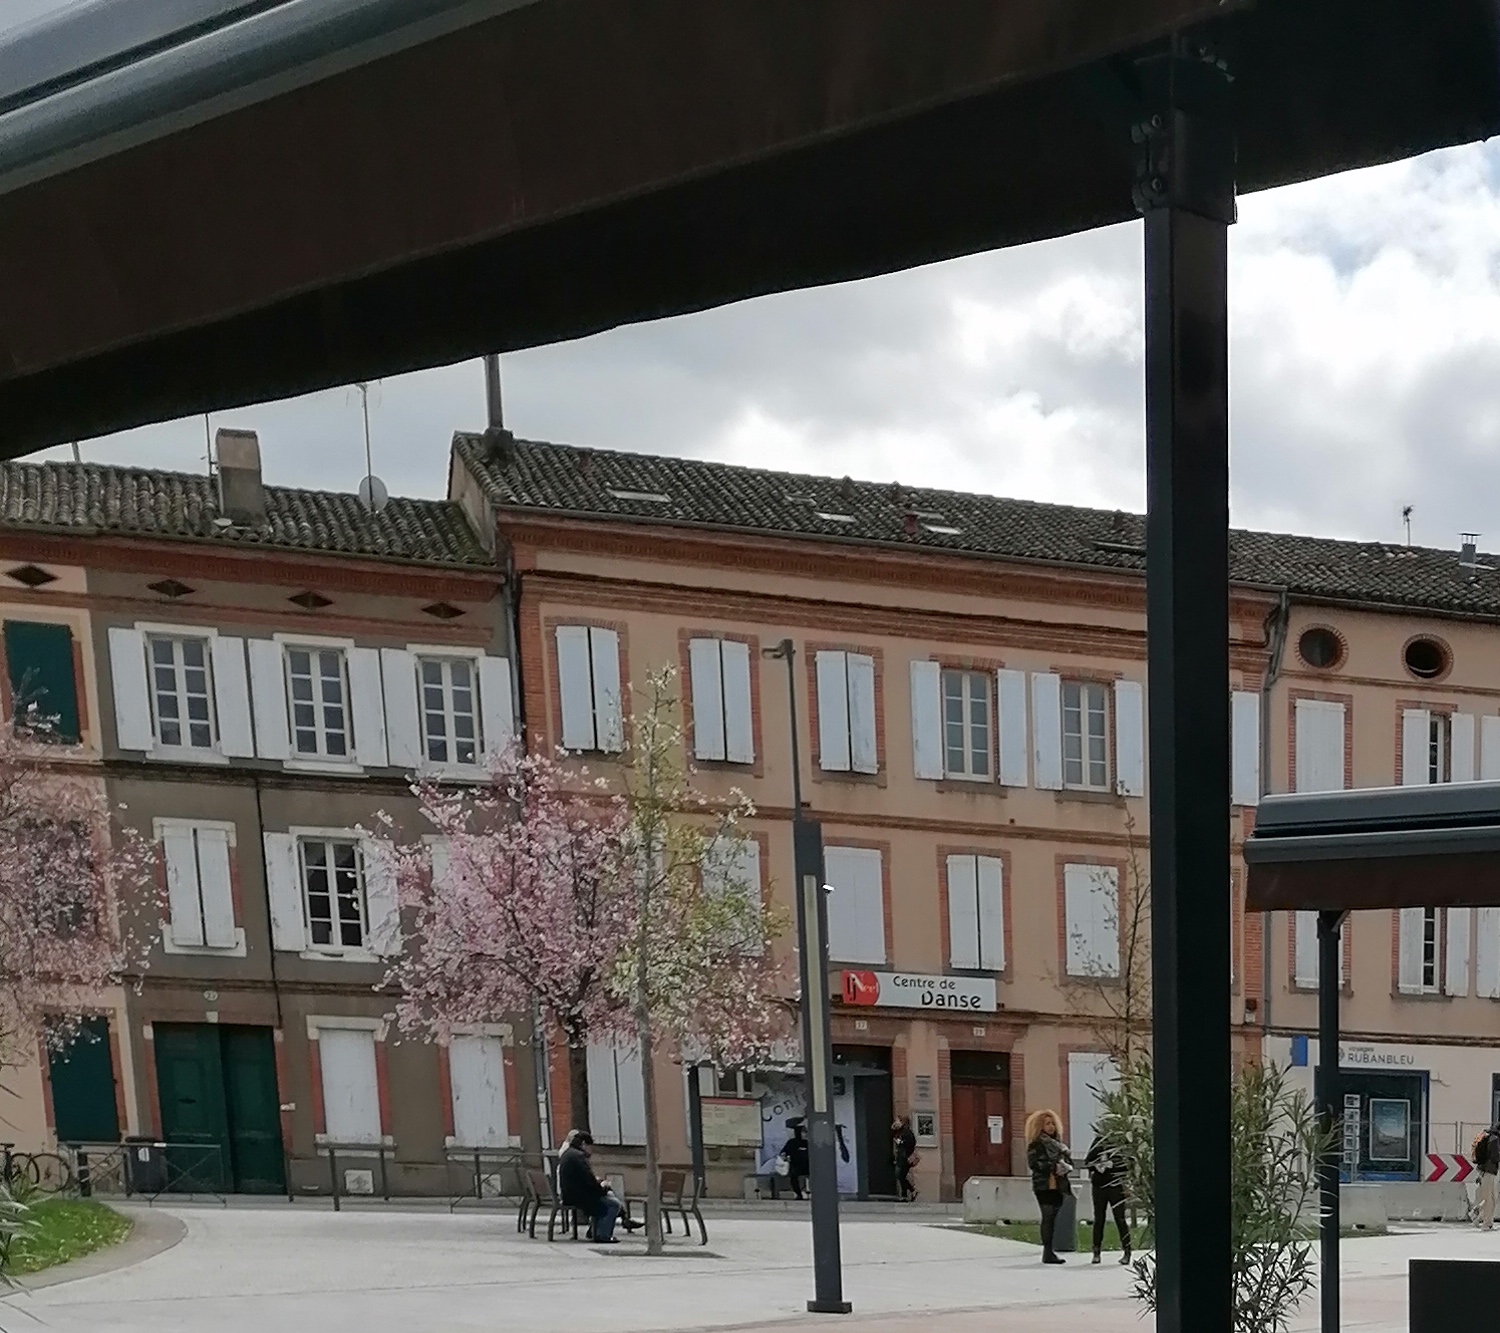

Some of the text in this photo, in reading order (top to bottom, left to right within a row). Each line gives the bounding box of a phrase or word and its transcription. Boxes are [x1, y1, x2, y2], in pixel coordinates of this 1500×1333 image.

[893, 975, 935, 989] Centre
[939, 979, 956, 990] de
[921, 990, 982, 1009] Danse
[1347, 1053, 1415, 1065] RUBANBLEU
